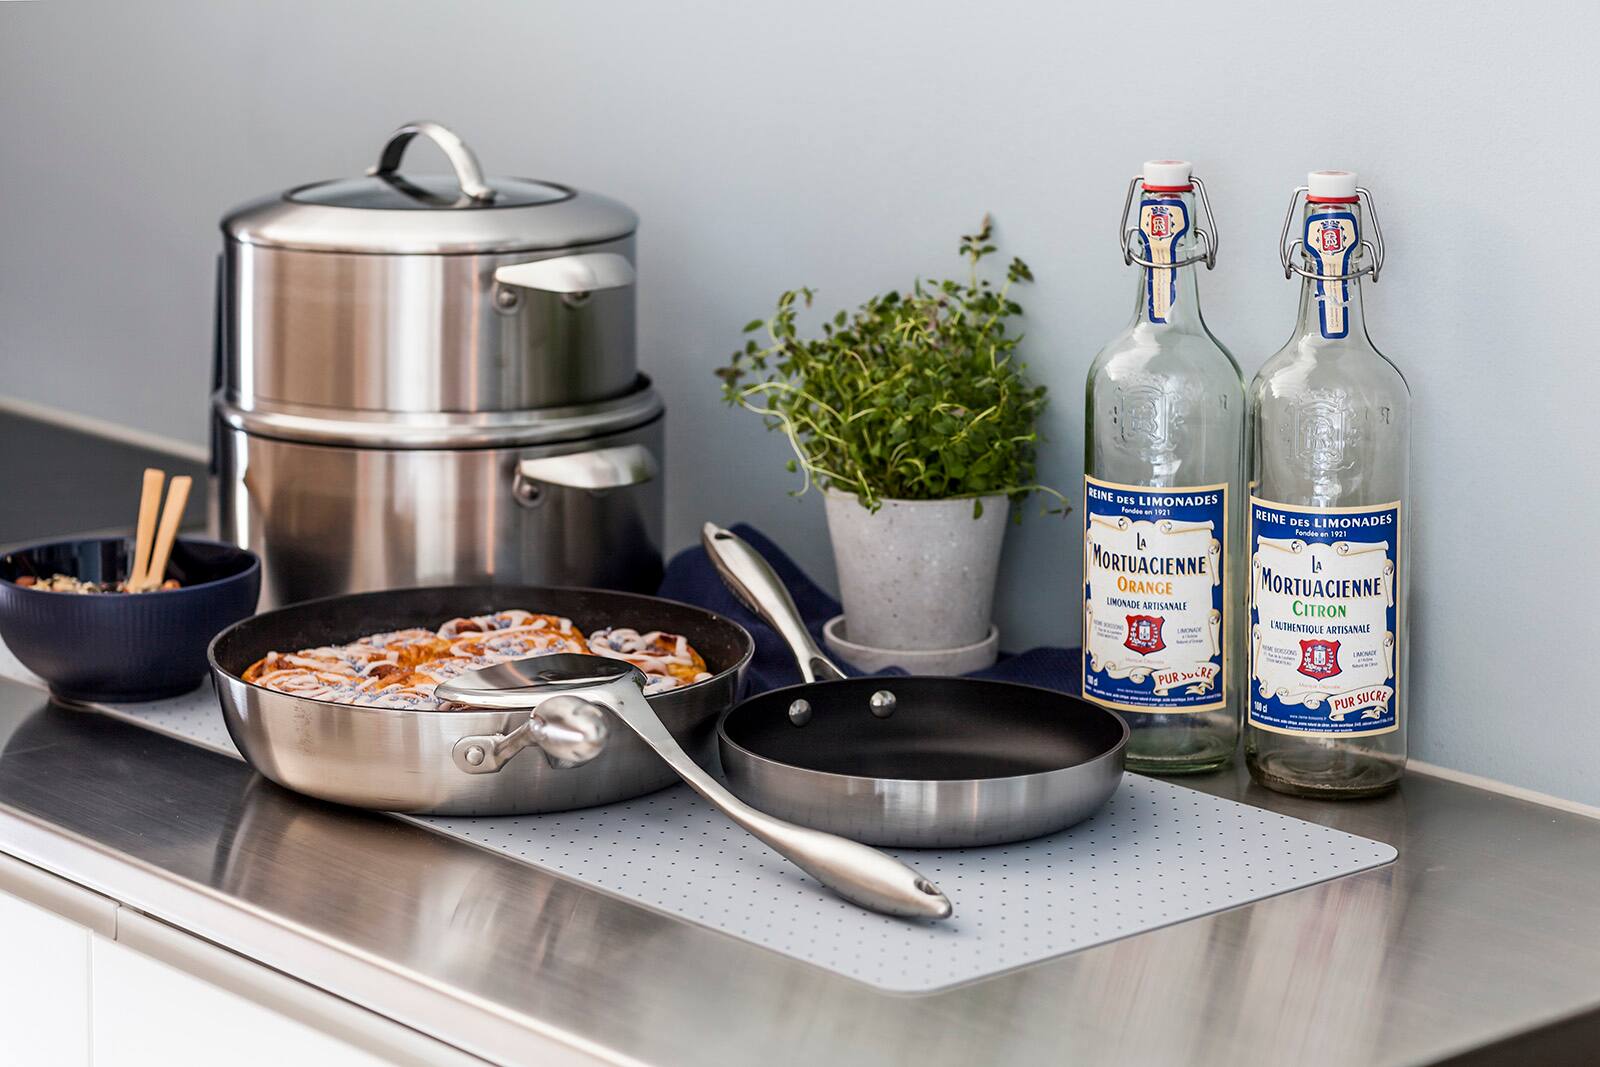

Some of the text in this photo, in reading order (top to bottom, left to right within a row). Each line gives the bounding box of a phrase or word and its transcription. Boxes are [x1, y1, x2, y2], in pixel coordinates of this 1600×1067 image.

[1088, 487, 1218, 507] REINE DES LIMONADES
[1255, 509, 1392, 528] REINE DES LIMONADES
[1106, 597, 1187, 611] LIMONADE ARTISANALE
[1270, 619, 1371, 635] L'AUTHENTIQUE ARTISANALE
[1159, 672, 1179, 685] PUR
[1334, 690, 1387, 710] PUR SUCRE
